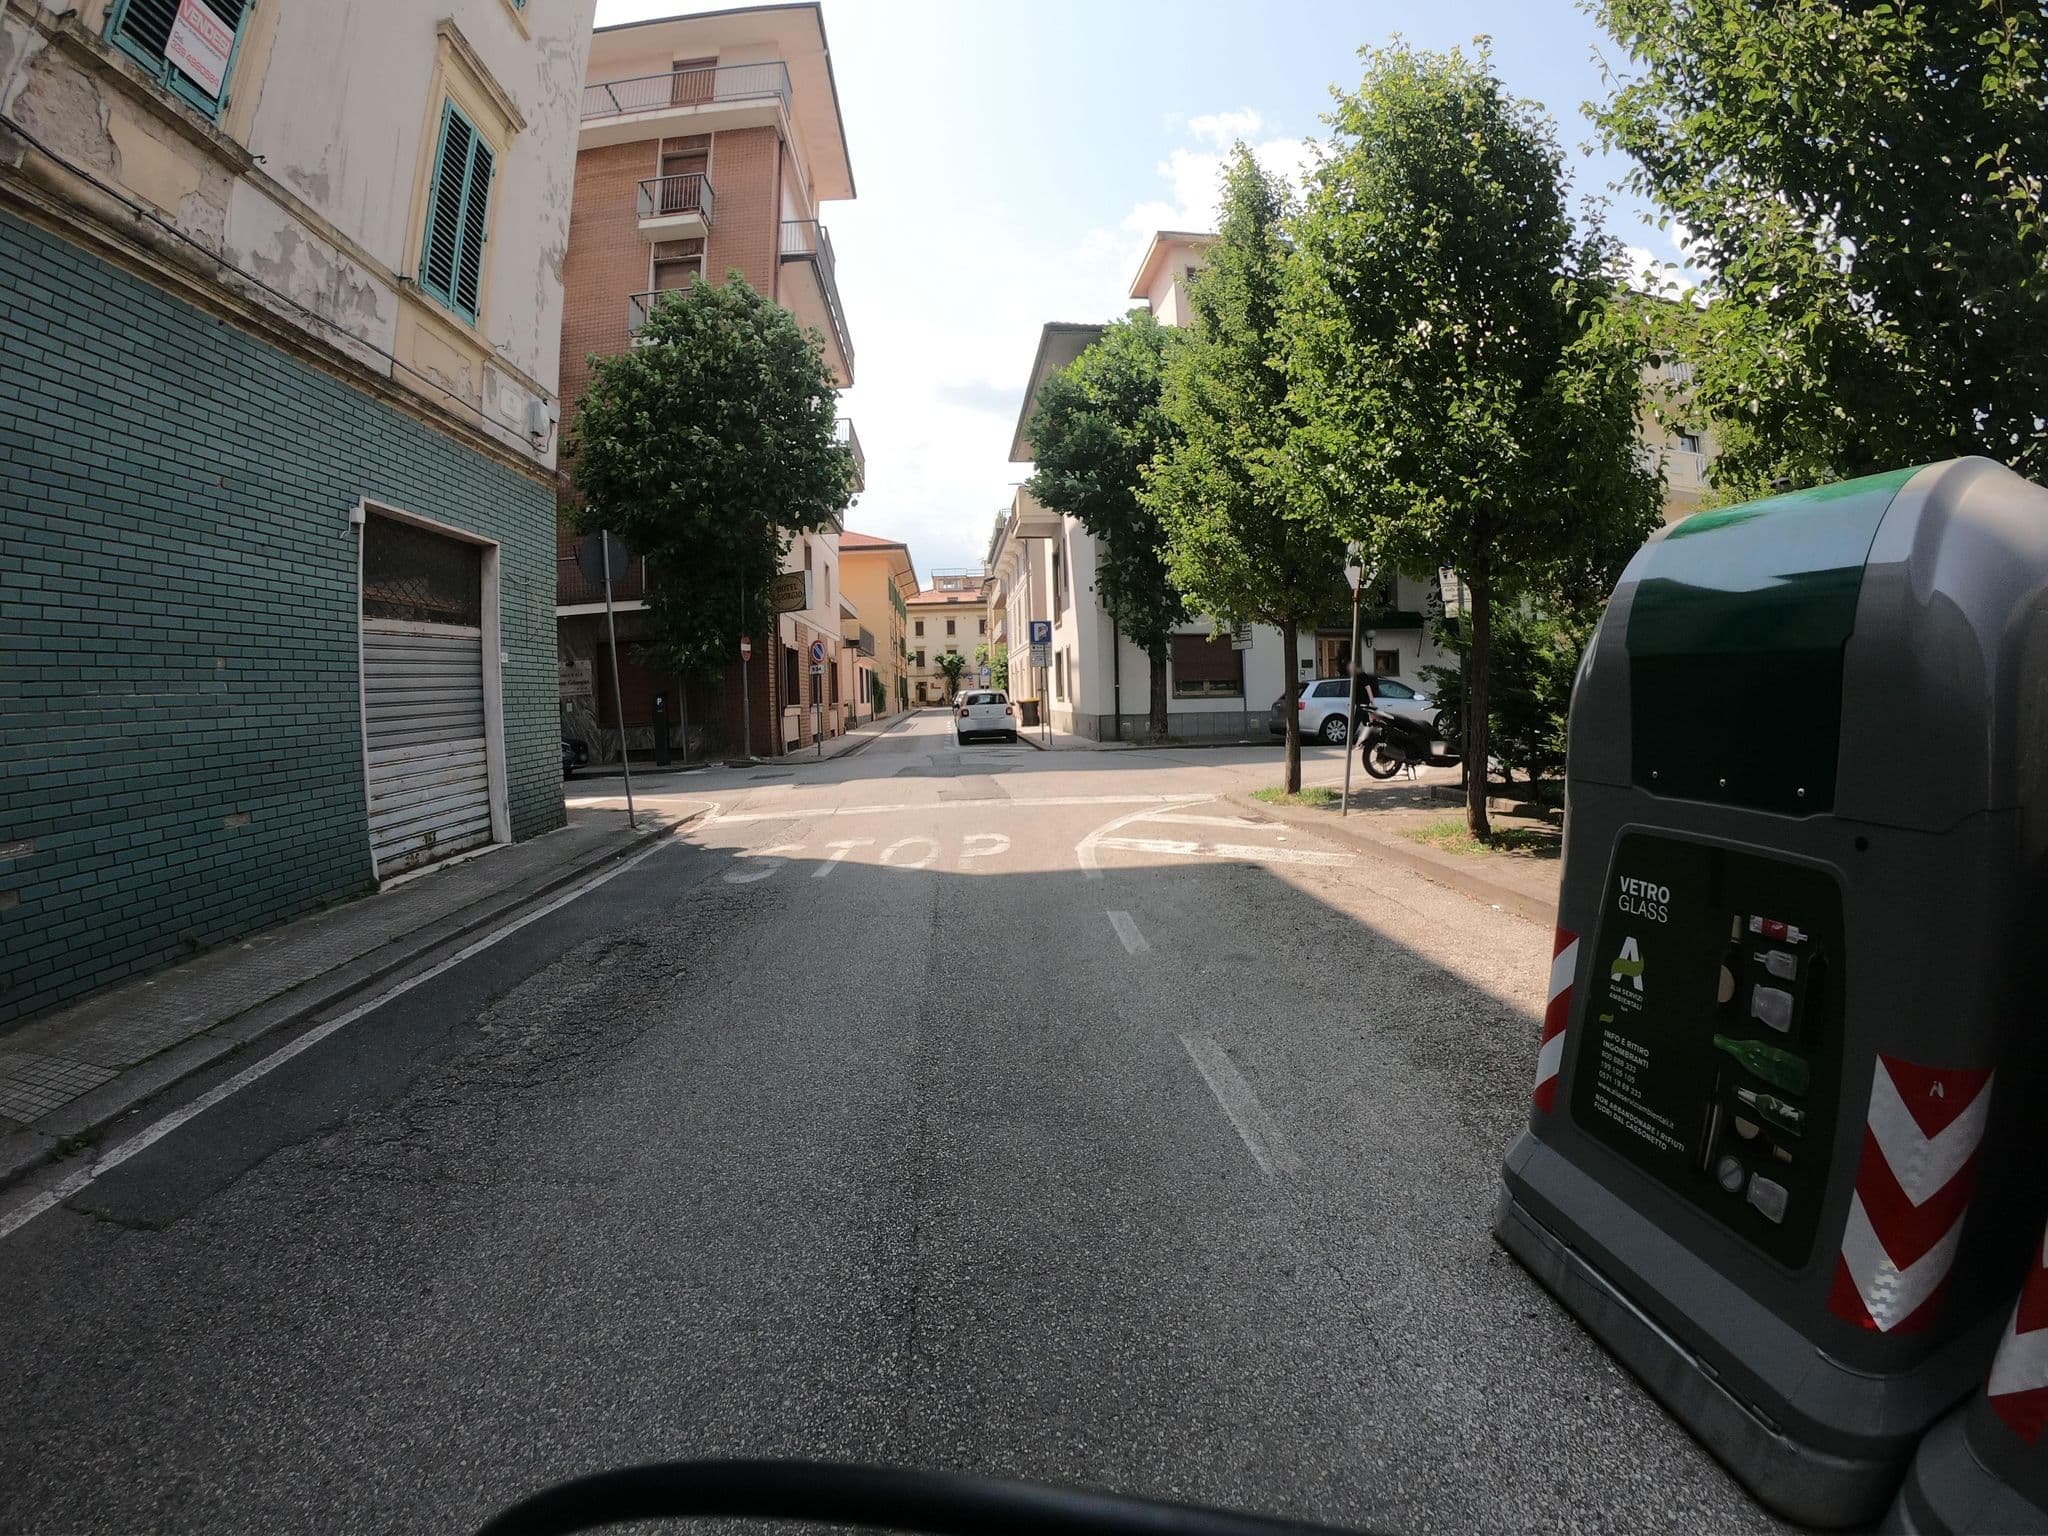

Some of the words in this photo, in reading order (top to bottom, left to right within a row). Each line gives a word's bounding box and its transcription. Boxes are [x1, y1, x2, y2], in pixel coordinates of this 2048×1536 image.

[181, 0, 232, 57] VENDESI
[776, 583, 796, 593] HOTEL
[722, 833, 1011, 884] STOP
[1620, 875, 1670, 904] VETRO
[1618, 894, 1668, 923] GLASS
[1609, 992, 1642, 1011] AMBIENTALI
[1622, 987, 1643, 1002] SERVIZI
[1602, 1040, 1649, 1069] INGOMBRANTI
[1604, 1029, 1620, 1042] INFO
[1626, 1040, 1650, 1057] RITIRO
[1593, 1101, 1612, 1118] FUORI
[1613, 1113, 1625, 1125] DAL
[1625, 1120, 1667, 1150] CASSONETTO
[1595, 1093, 1608, 1106] NON
[1609, 1102, 1656, 1135] ABBANDONARE
[1660, 1132, 1685, 1152] RIFIUTI
